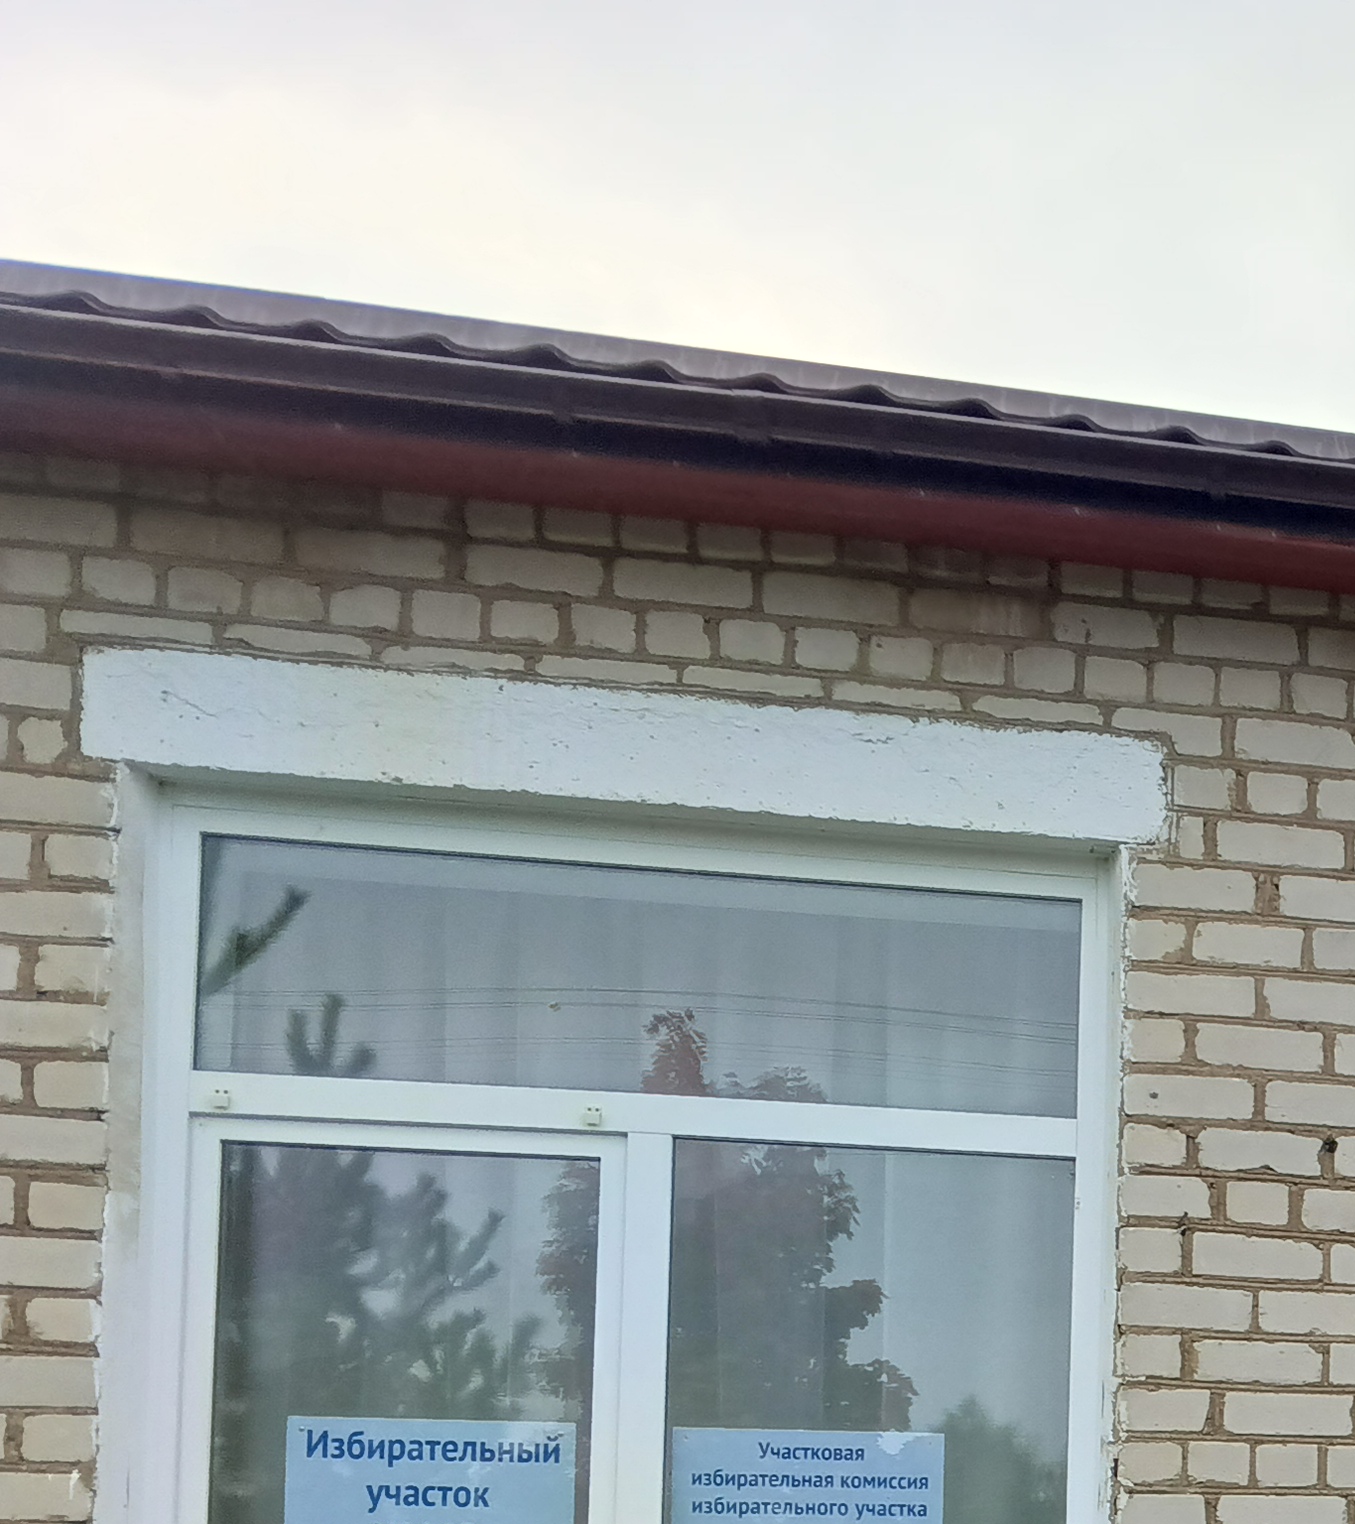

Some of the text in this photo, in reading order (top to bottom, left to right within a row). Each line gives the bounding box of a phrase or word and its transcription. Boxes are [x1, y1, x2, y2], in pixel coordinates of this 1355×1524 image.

[306, 1429, 560, 1467] Избирательный
[758, 1441, 865, 1461] Участковая
[691, 1469, 929, 1491] избирательная комиссия
[366, 1484, 490, 1513] участок
[691, 1497, 927, 1520] избирательного участка
